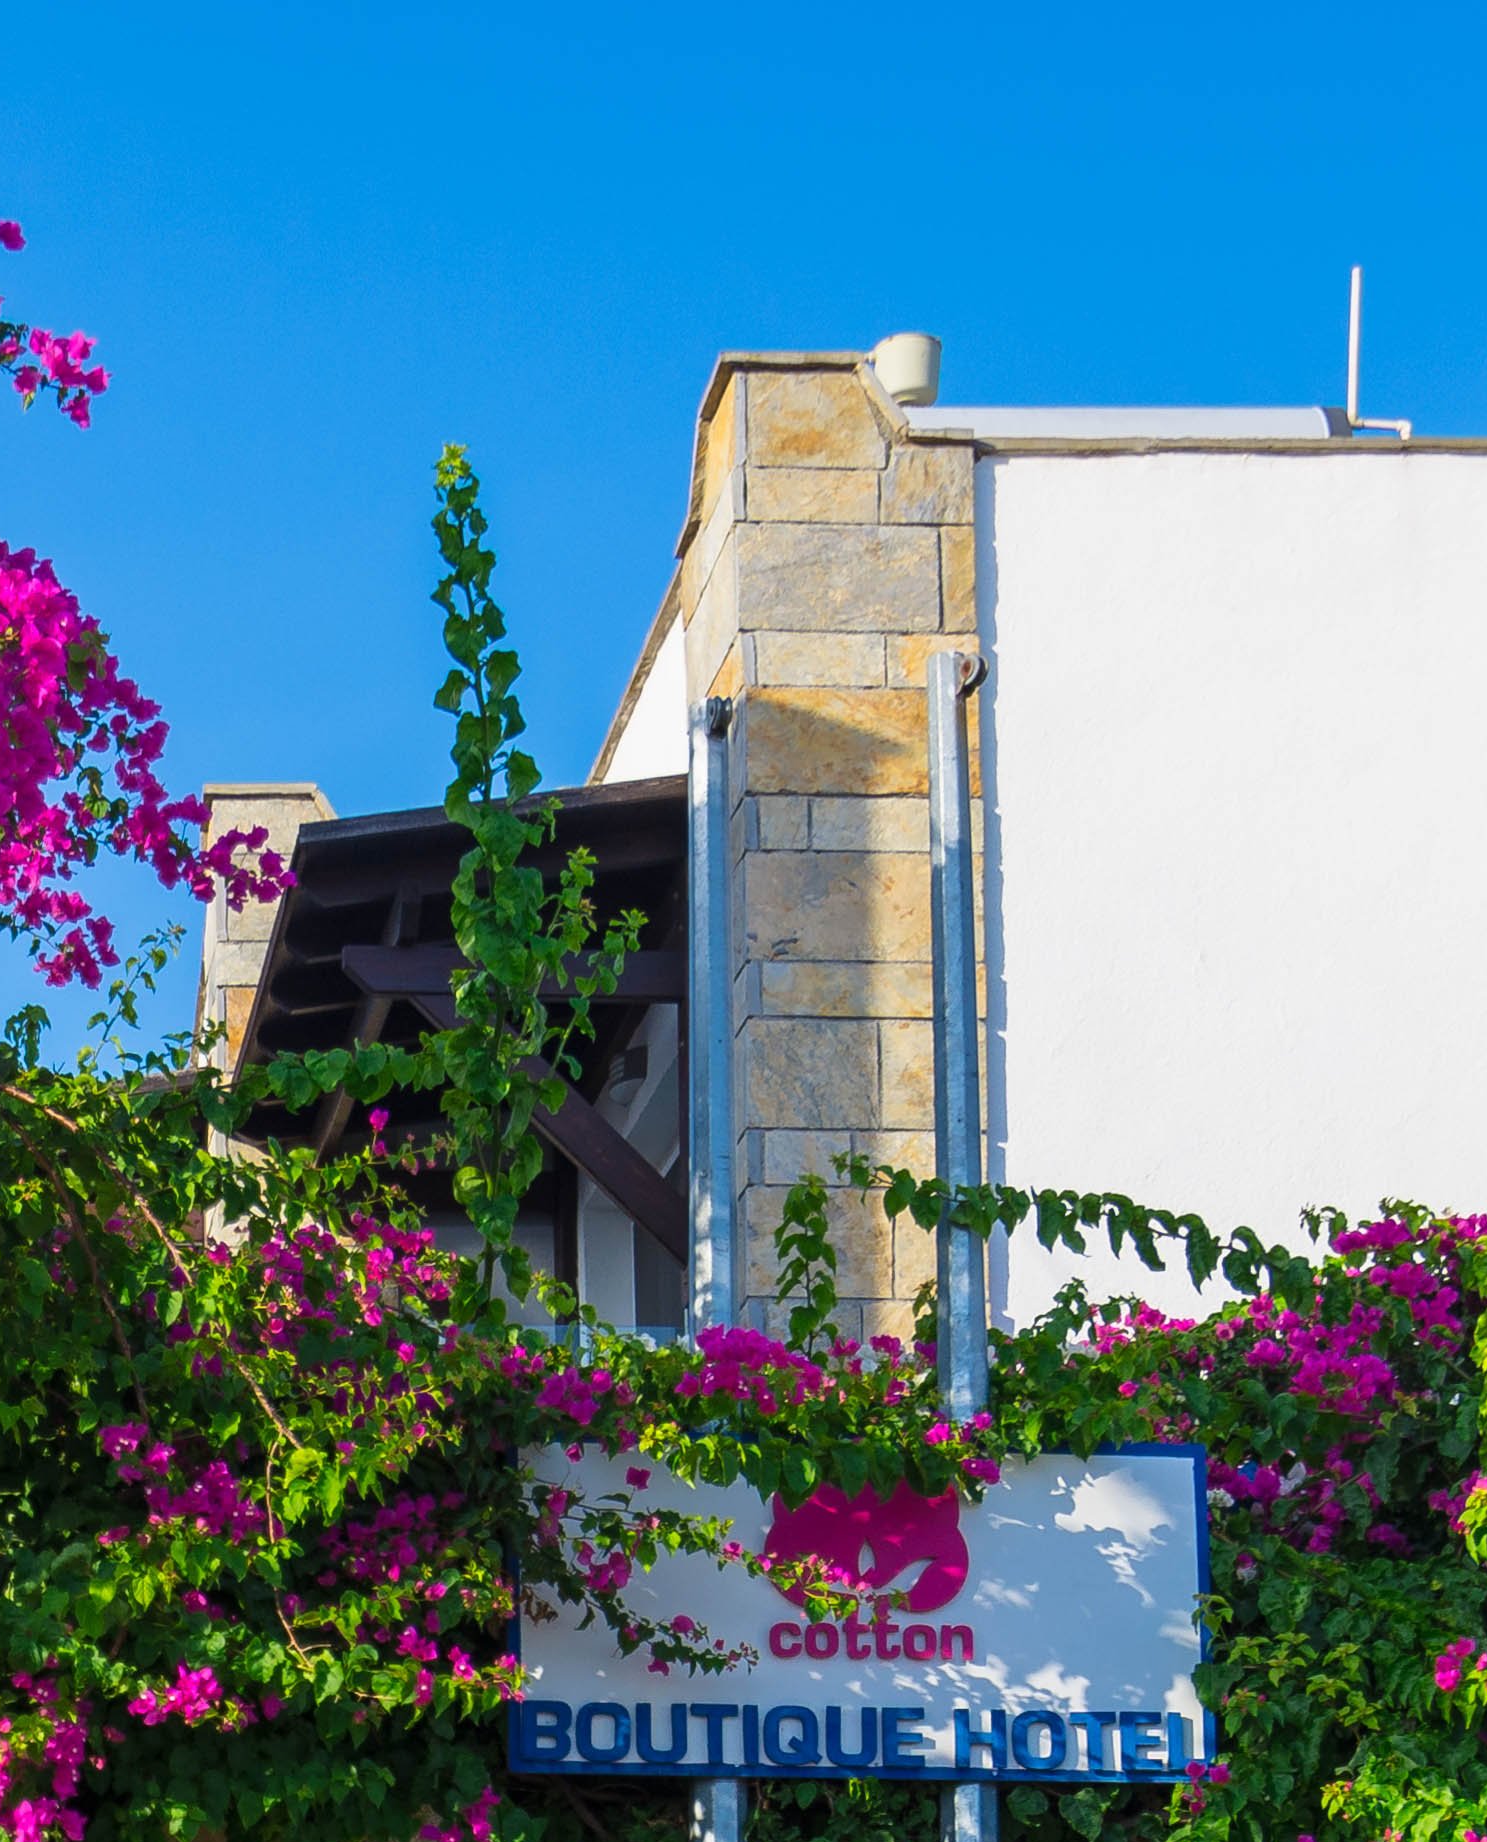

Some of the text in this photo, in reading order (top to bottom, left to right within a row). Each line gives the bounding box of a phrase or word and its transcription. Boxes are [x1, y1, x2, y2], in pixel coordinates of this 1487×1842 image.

[769, 1604, 974, 1661] cotton
[522, 1701, 1204, 1771] BOUTIQUE HOTEL
